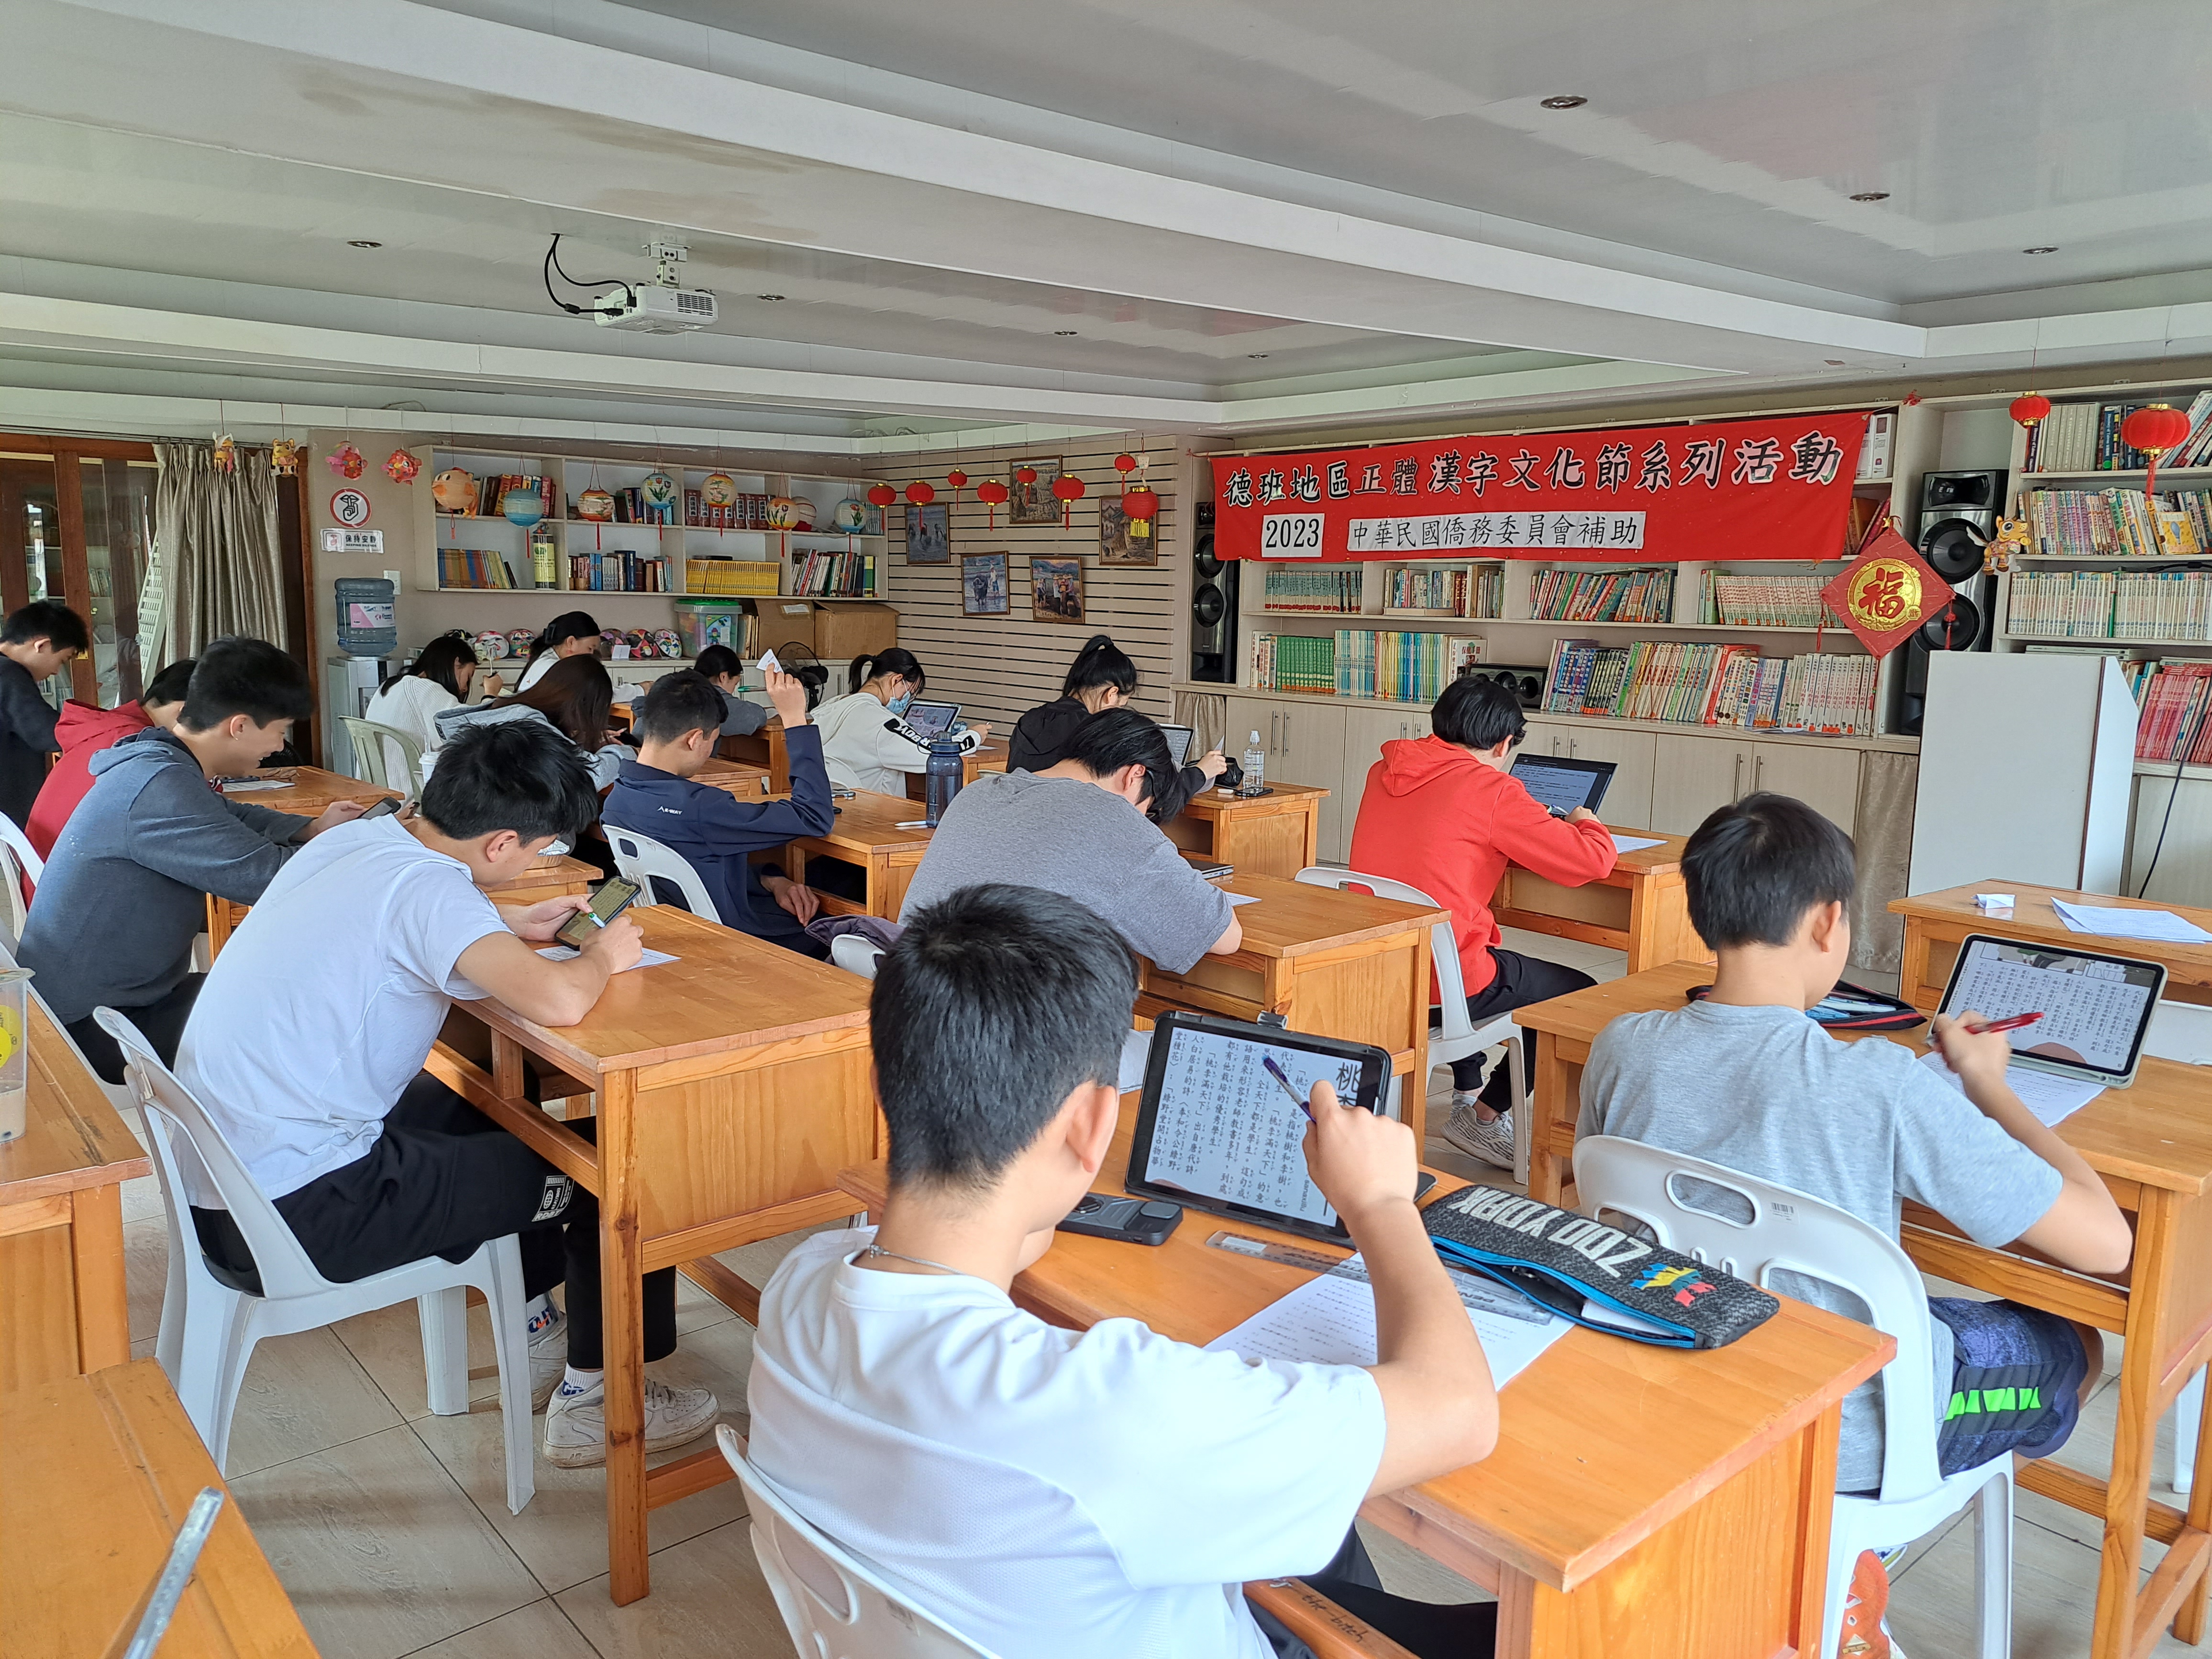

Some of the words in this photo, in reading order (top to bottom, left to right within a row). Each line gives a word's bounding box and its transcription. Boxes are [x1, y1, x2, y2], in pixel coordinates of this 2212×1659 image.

[1226, 431, 1840, 507] 德班地區正體漢字文化節系列活動
[346, 535, 376, 543] 保持安靜
[1266, 521, 1320, 549] 2023
[1352, 514, 1639, 550] 中華民國僑務委員會補助
[1858, 567, 1906, 618] 福
[1448, 1186, 1562, 1238] YORK
[1547, 1232, 1653, 1278] ZOO
